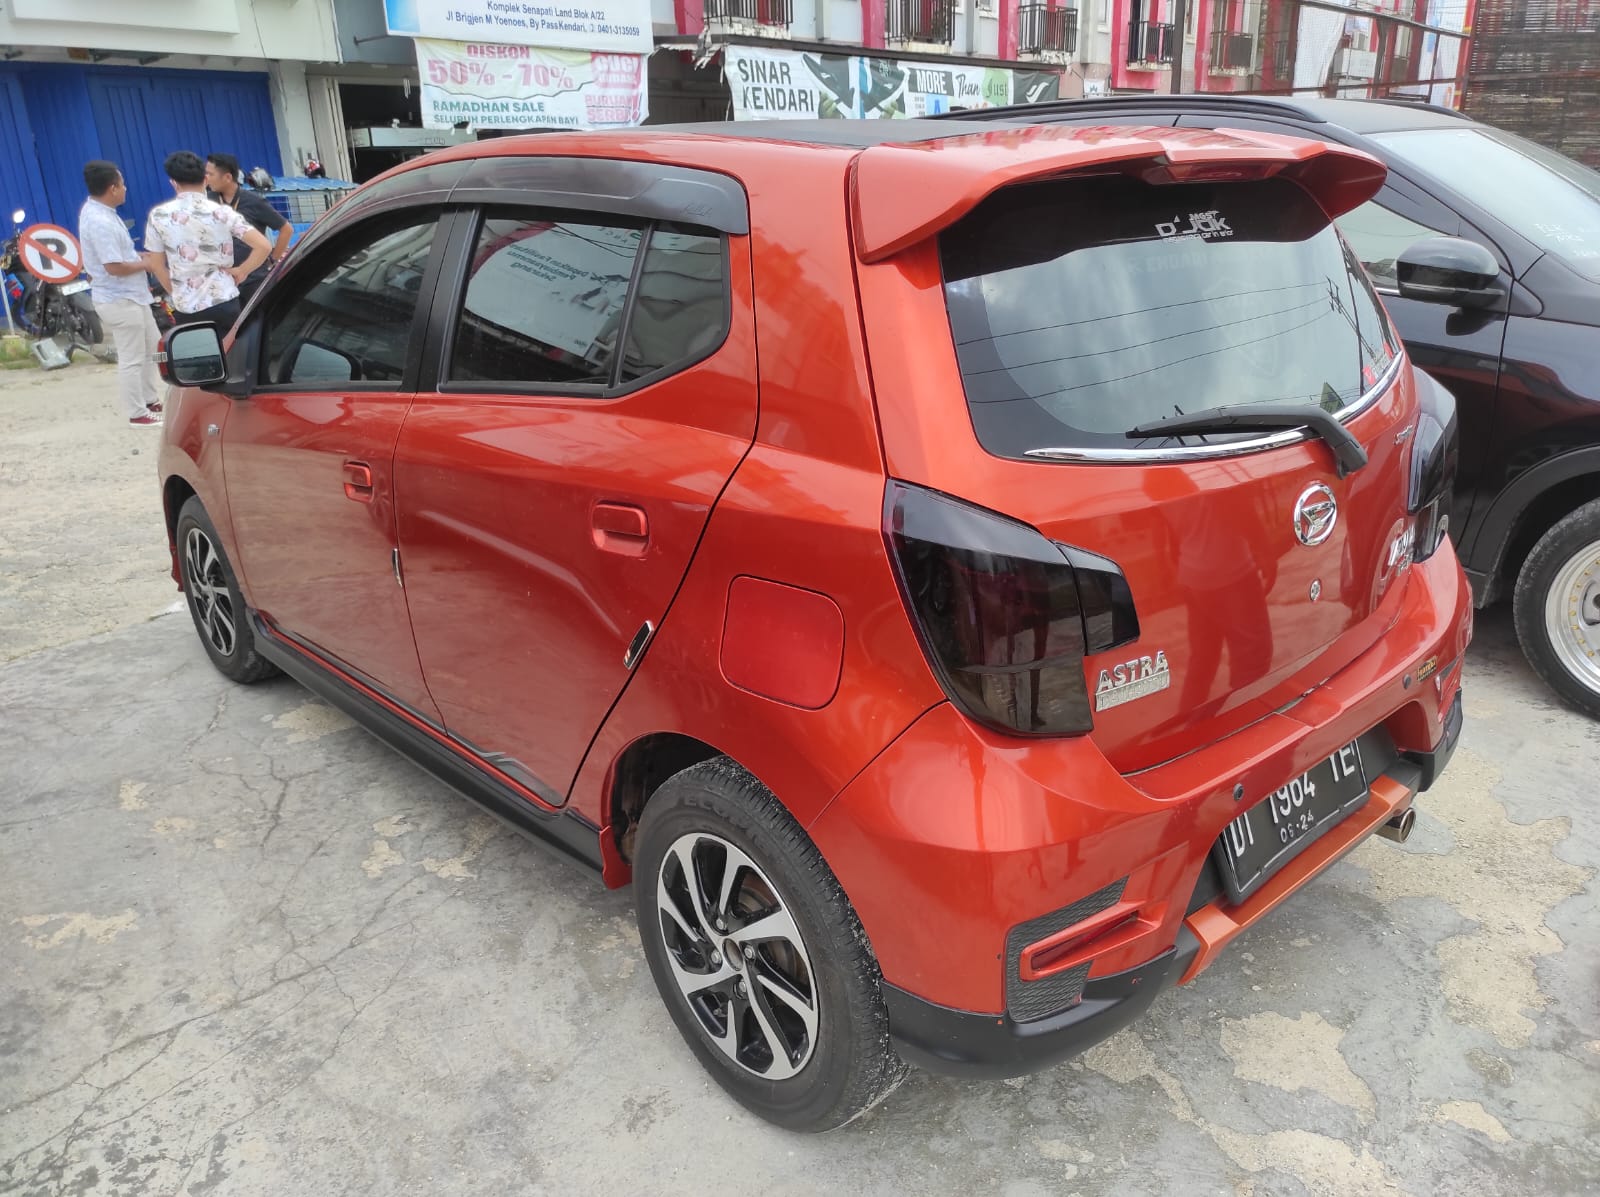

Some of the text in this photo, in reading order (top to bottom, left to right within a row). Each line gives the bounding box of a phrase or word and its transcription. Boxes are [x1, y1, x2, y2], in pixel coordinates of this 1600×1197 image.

[455, 12, 484, 26] Brigjen
[485, 14, 493, 24] M
[494, 15, 528, 29] Yoenoes,
[529, 18, 540, 31] By
[487, 0, 605, 21] Komplek Senapati Land Blok A/22
[466, 44, 531, 59] DISKON
[428, 59, 496, 86] 50%
[518, 63, 574, 89] 70%
[737, 58, 791, 85] SINAR
[915, 69, 948, 94] MORE
[955, 72, 980, 99] Than
[433, 100, 545, 113] RAMADHAN SALE
[743, 84, 815, 112] KENDARI
[433, 114, 579, 125] SELURUH PERLENGKAPAN BAYI
[34, 237, 68, 271] P
[1095, 649, 1169, 694] ASTRA
[1269, 770, 1316, 824] 1904
